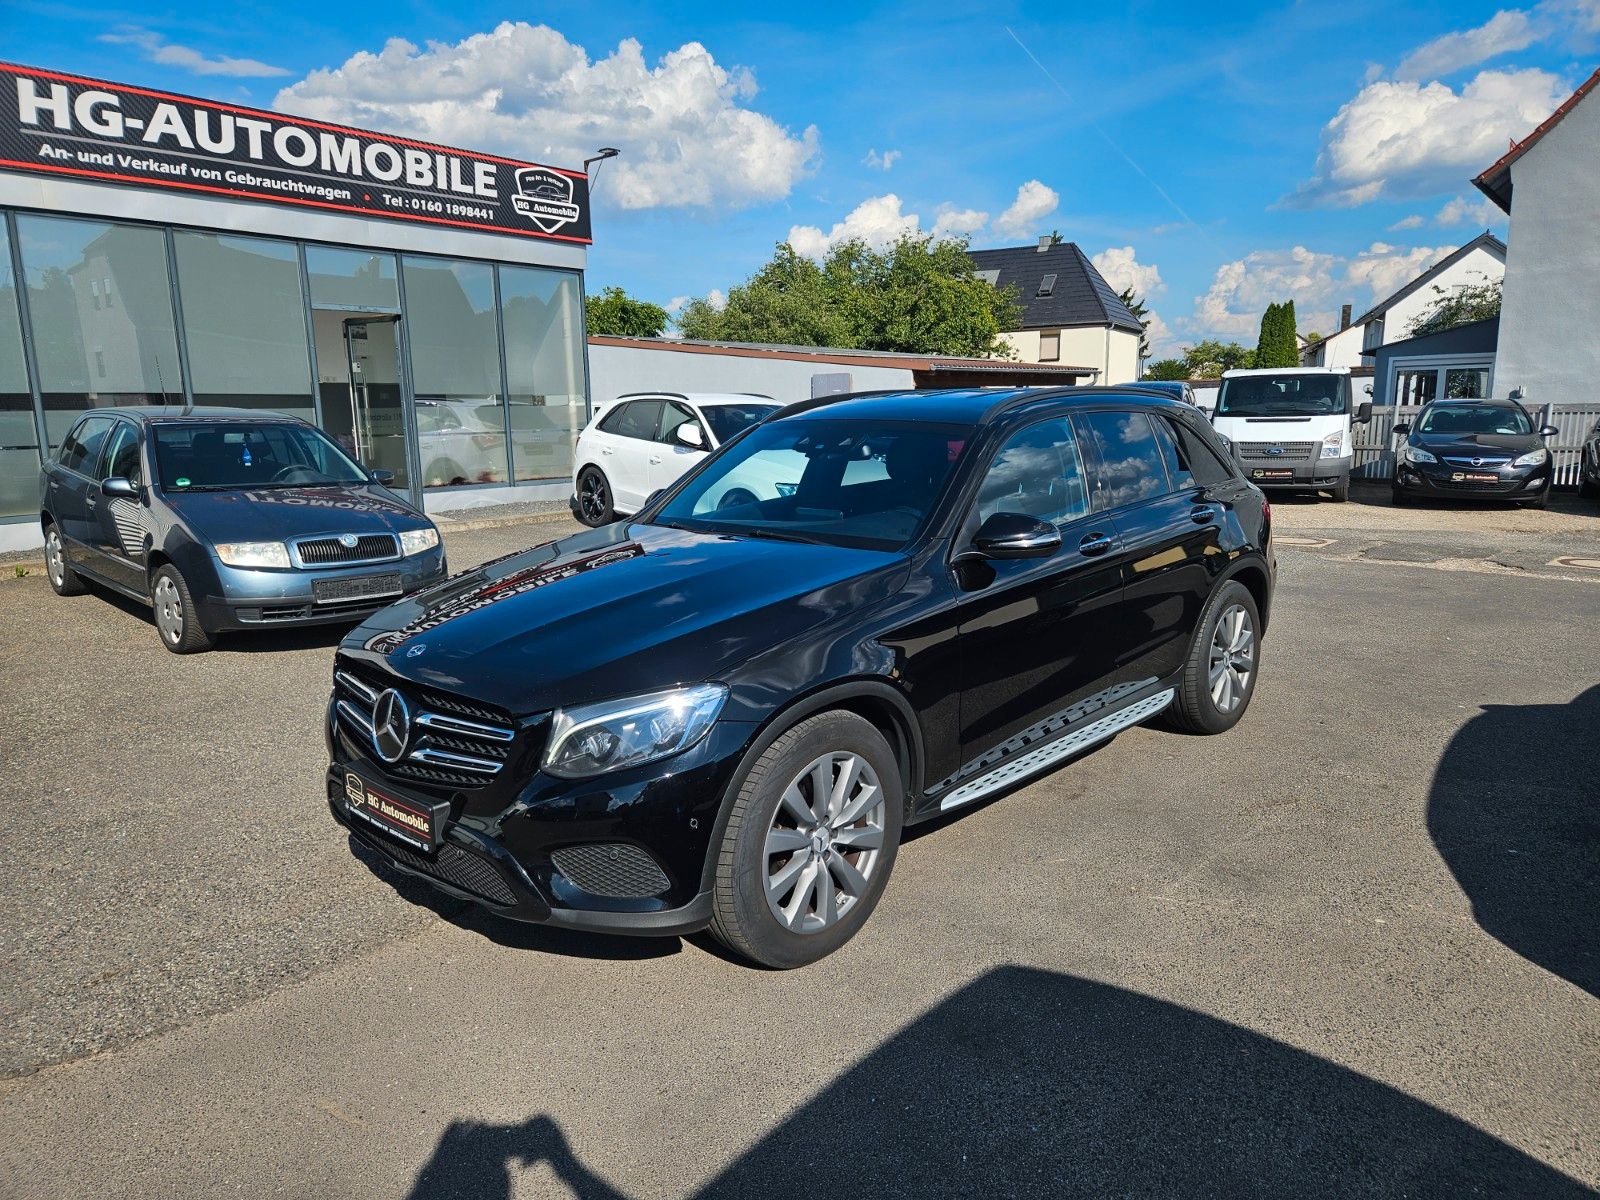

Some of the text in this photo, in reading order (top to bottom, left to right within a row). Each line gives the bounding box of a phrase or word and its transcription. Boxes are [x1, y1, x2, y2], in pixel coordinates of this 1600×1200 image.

[16, 77, 498, 198] HG-AUTOMOBILE
[38, 143, 351, 200] An- und Verkauf von Gebrauchtwagen
[411, 198, 443, 213] 0160
[445, 203, 495, 220] 1898441
[517, 200, 577, 217] HG Automobile
[367, 792, 380, 809] HG
[380, 800, 430, 833] Automobile
